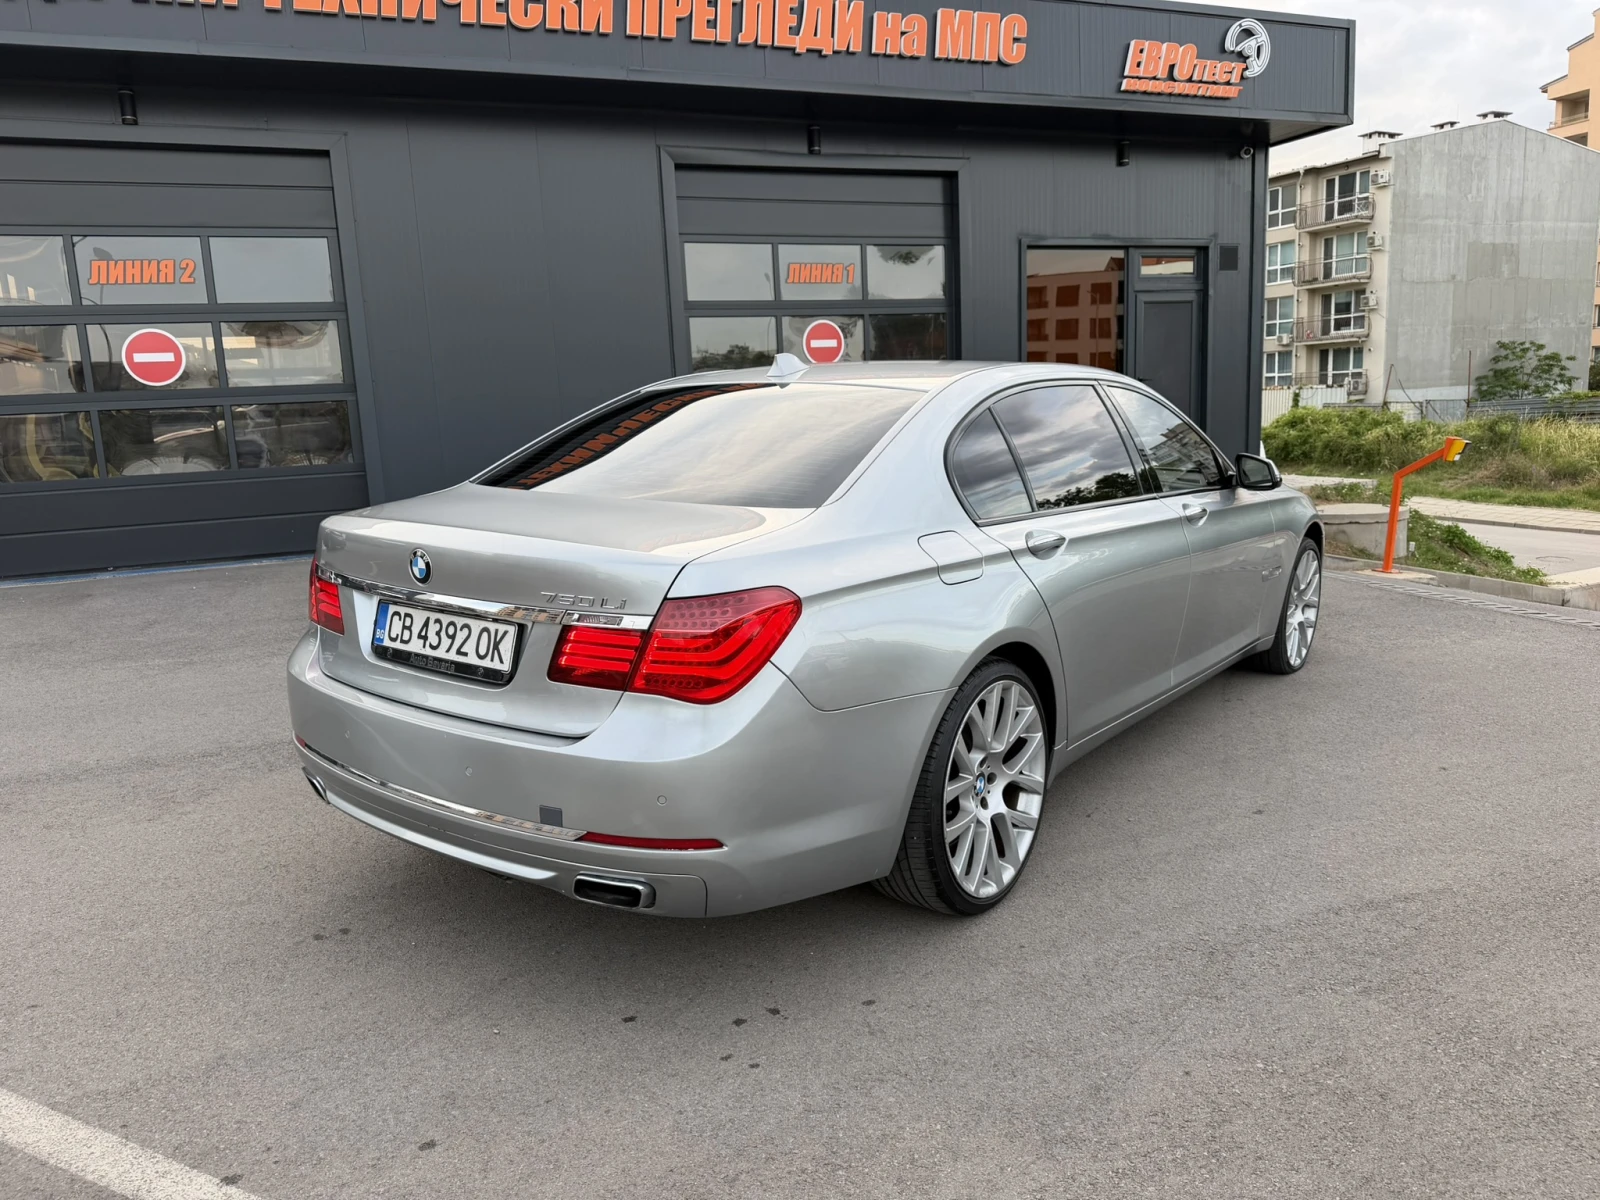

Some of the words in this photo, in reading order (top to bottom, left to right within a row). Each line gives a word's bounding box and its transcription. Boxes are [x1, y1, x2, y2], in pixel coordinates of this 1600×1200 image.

[625, 0, 864, 55] ПРЕГЛЕДИ
[871, 11, 928, 57] на
[934, 8, 1028, 65] МПС
[88, 259, 175, 285] ЛИНИЯ
[179, 259, 196, 284] 2
[785, 263, 844, 284] ЛИНИЯ
[845, 263, 855, 284] 1
[540, 591, 595, 607] 750
[376, 628, 385, 639] BG
[388, 611, 413, 644] CB
[417, 616, 472, 657] 4392
[475, 626, 509, 664] OK
